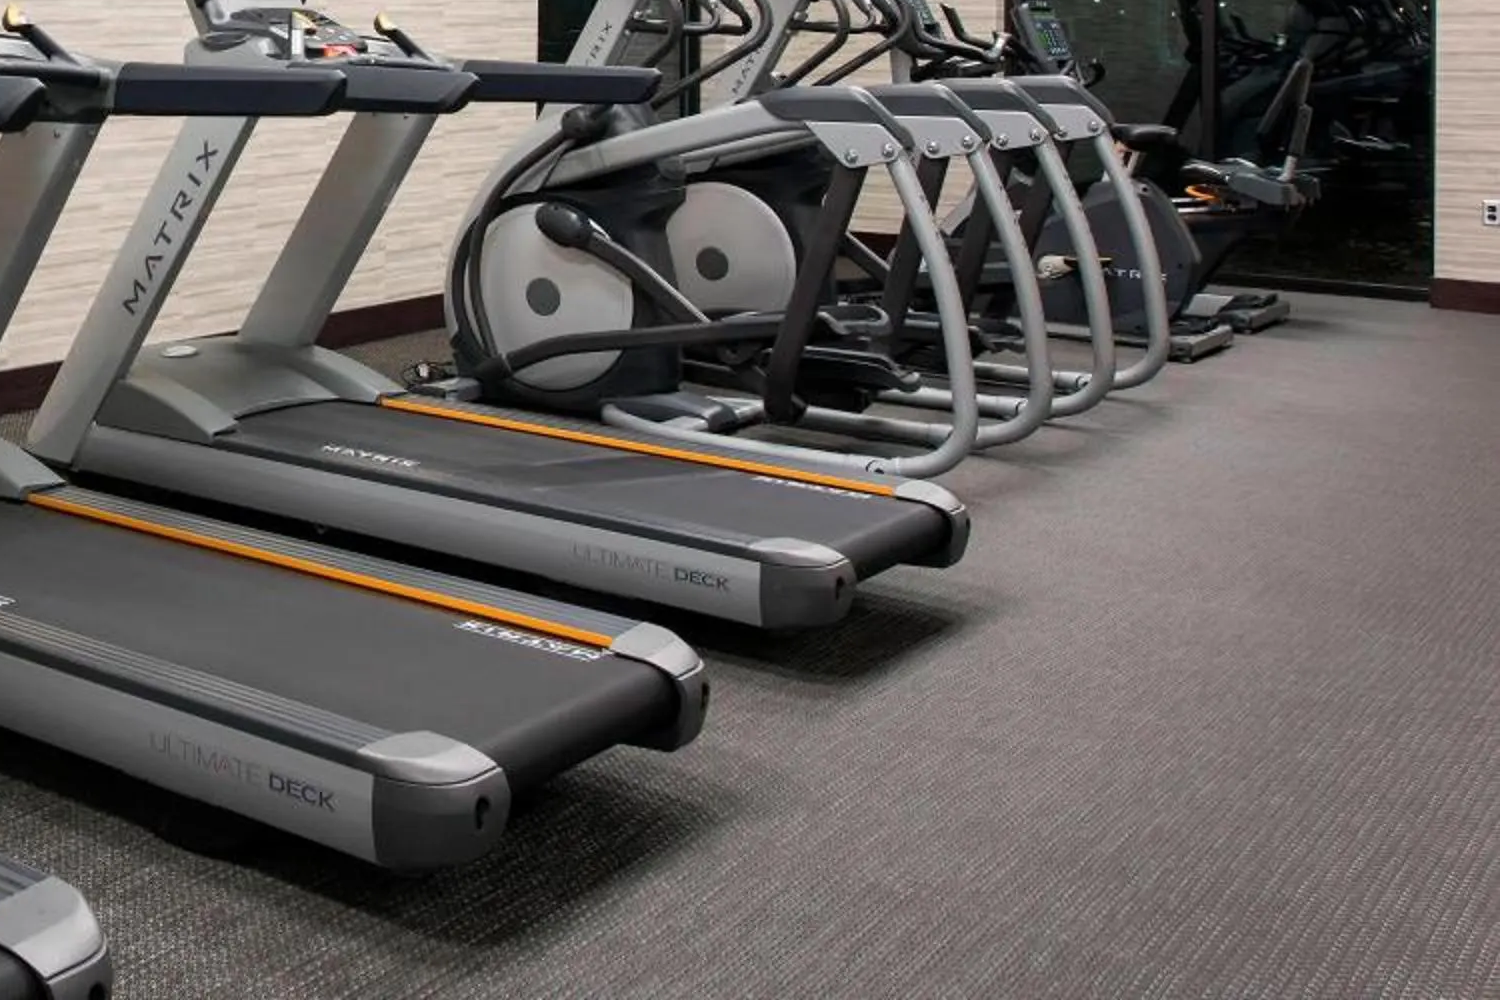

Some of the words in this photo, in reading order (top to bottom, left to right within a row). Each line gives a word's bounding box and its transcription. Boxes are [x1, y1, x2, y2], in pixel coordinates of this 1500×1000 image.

[122, 139, 219, 317] MATRIX
[570, 540, 672, 581] ULTIMATE
[674, 566, 732, 590] DECK
[457, 620, 602, 661] MATRIX
[148, 730, 264, 786] ULTIMATE
[268, 771, 336, 812] DECK
